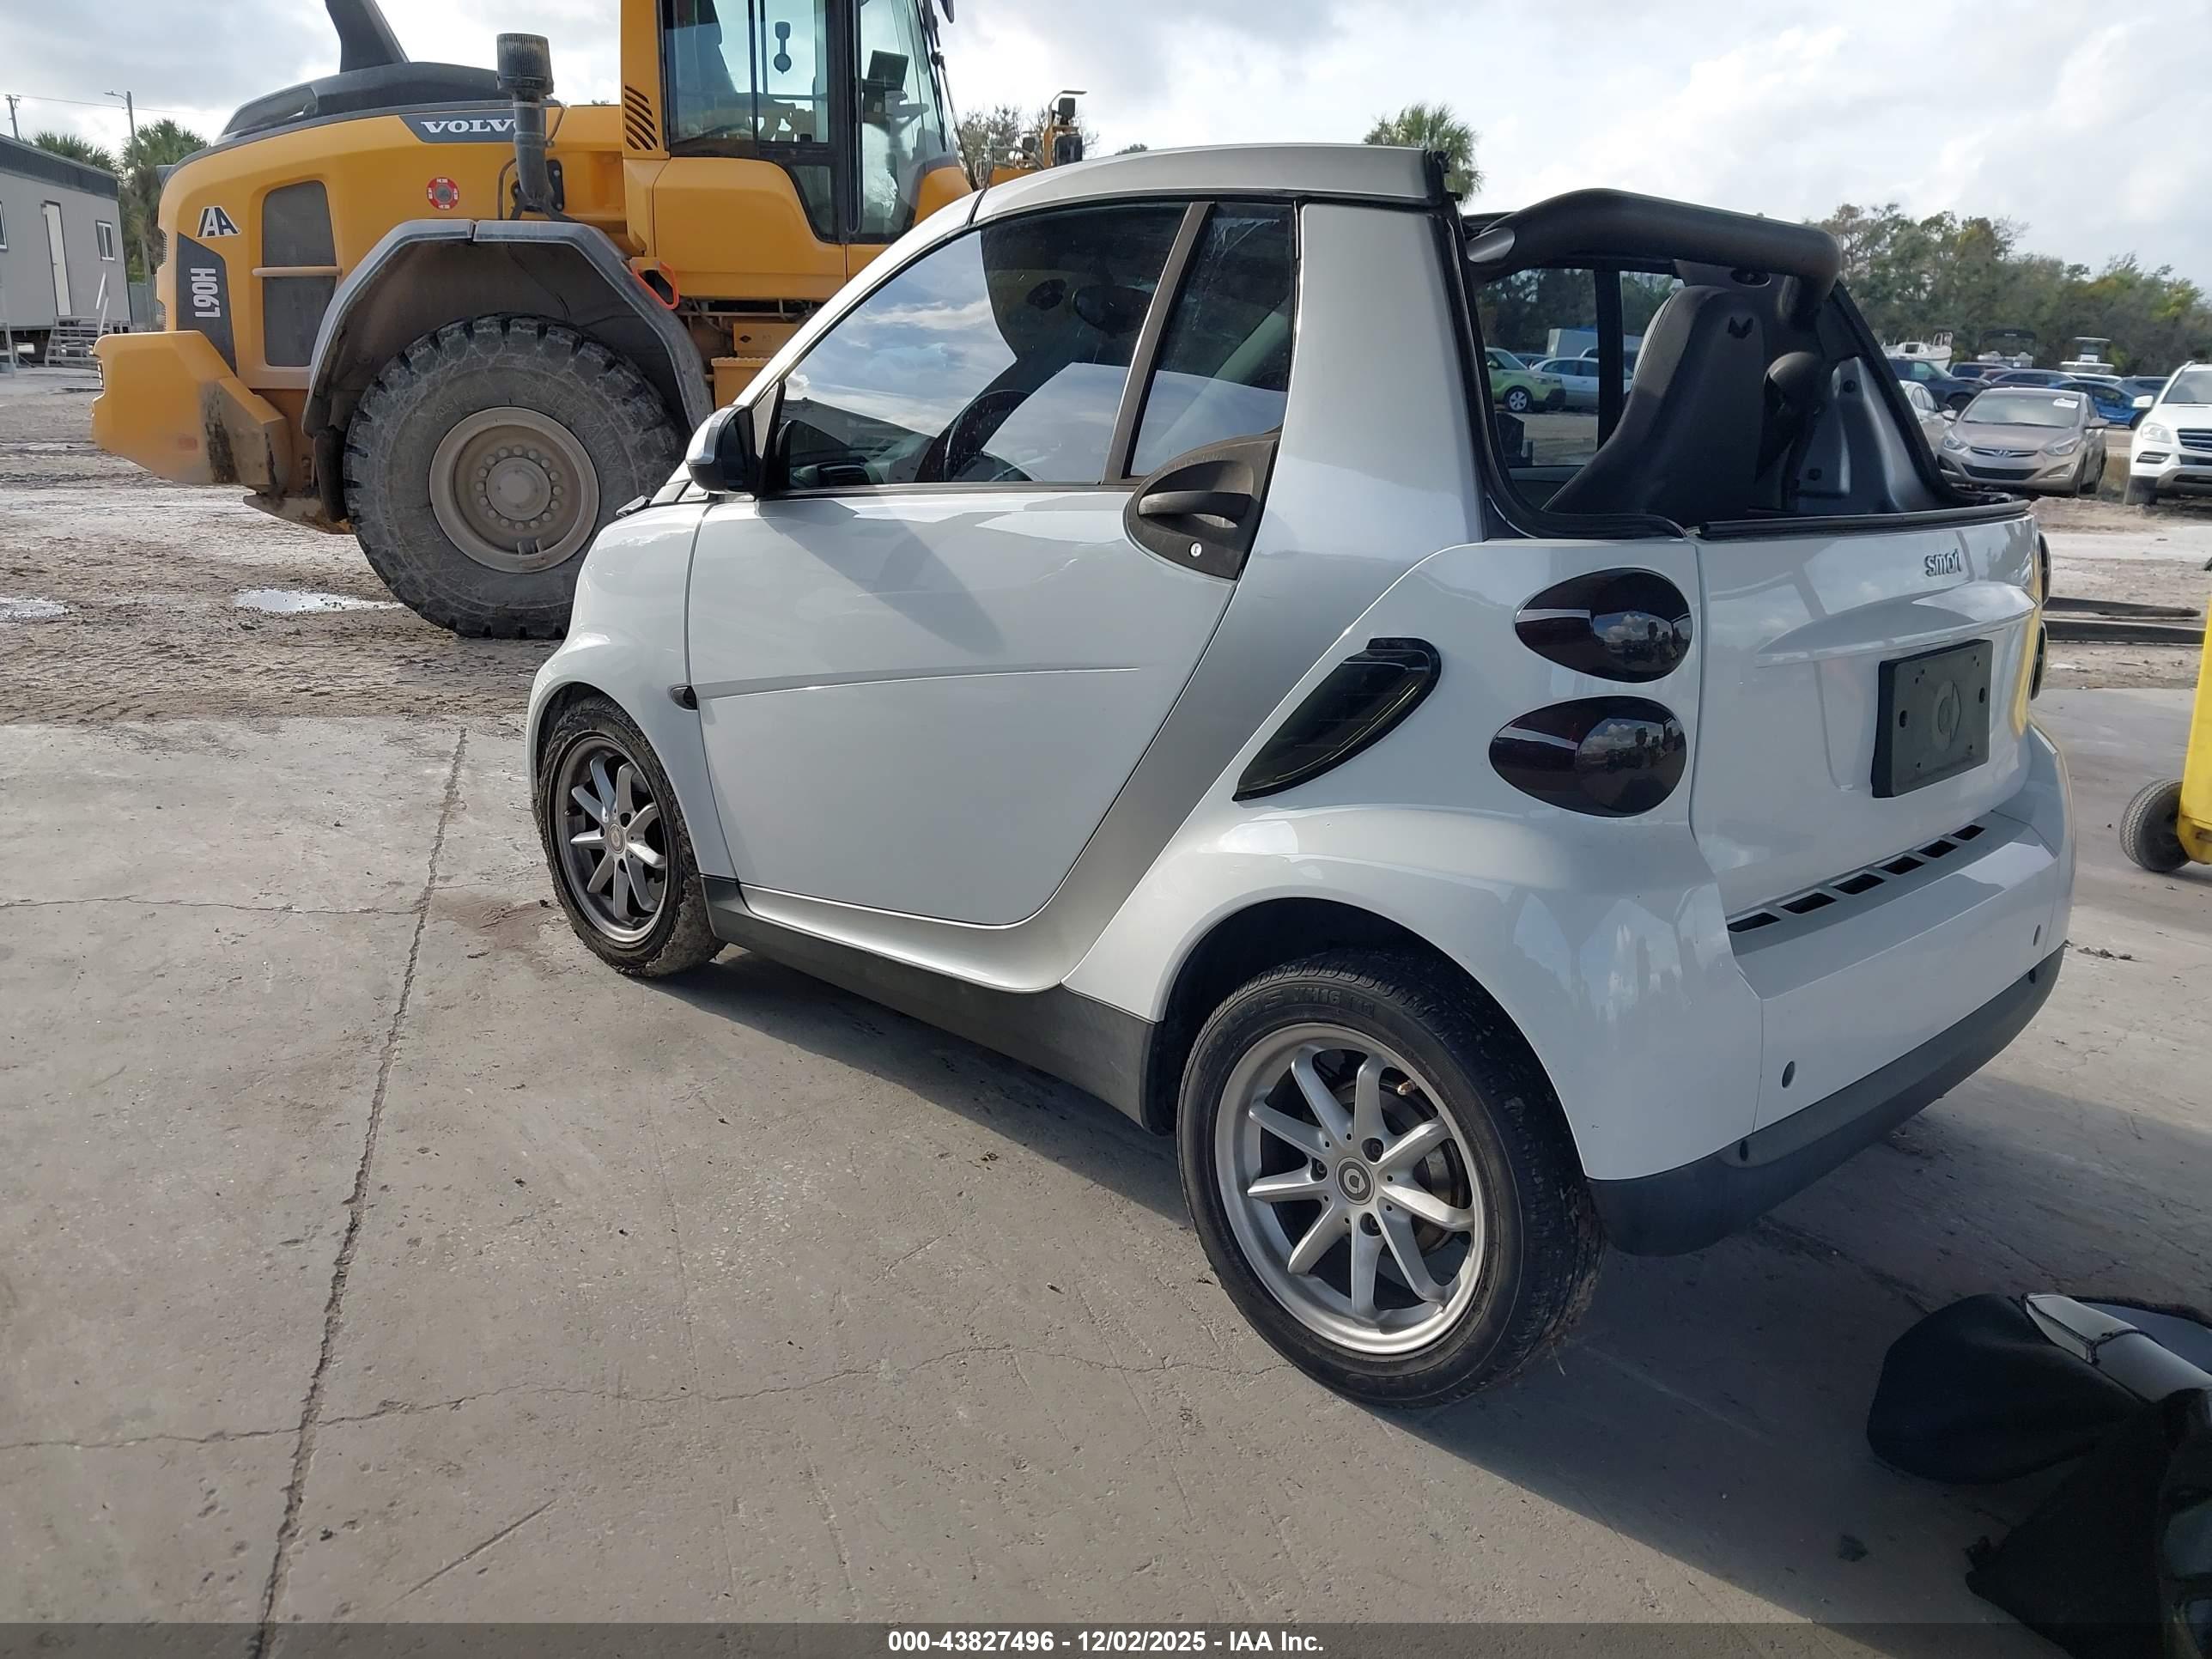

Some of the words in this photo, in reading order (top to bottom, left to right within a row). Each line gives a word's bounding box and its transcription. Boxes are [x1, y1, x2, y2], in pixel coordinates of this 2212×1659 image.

[421, 118, 515, 133] VOLV
[190, 267, 222, 318] L90H
[1924, 548, 1962, 578] smart
